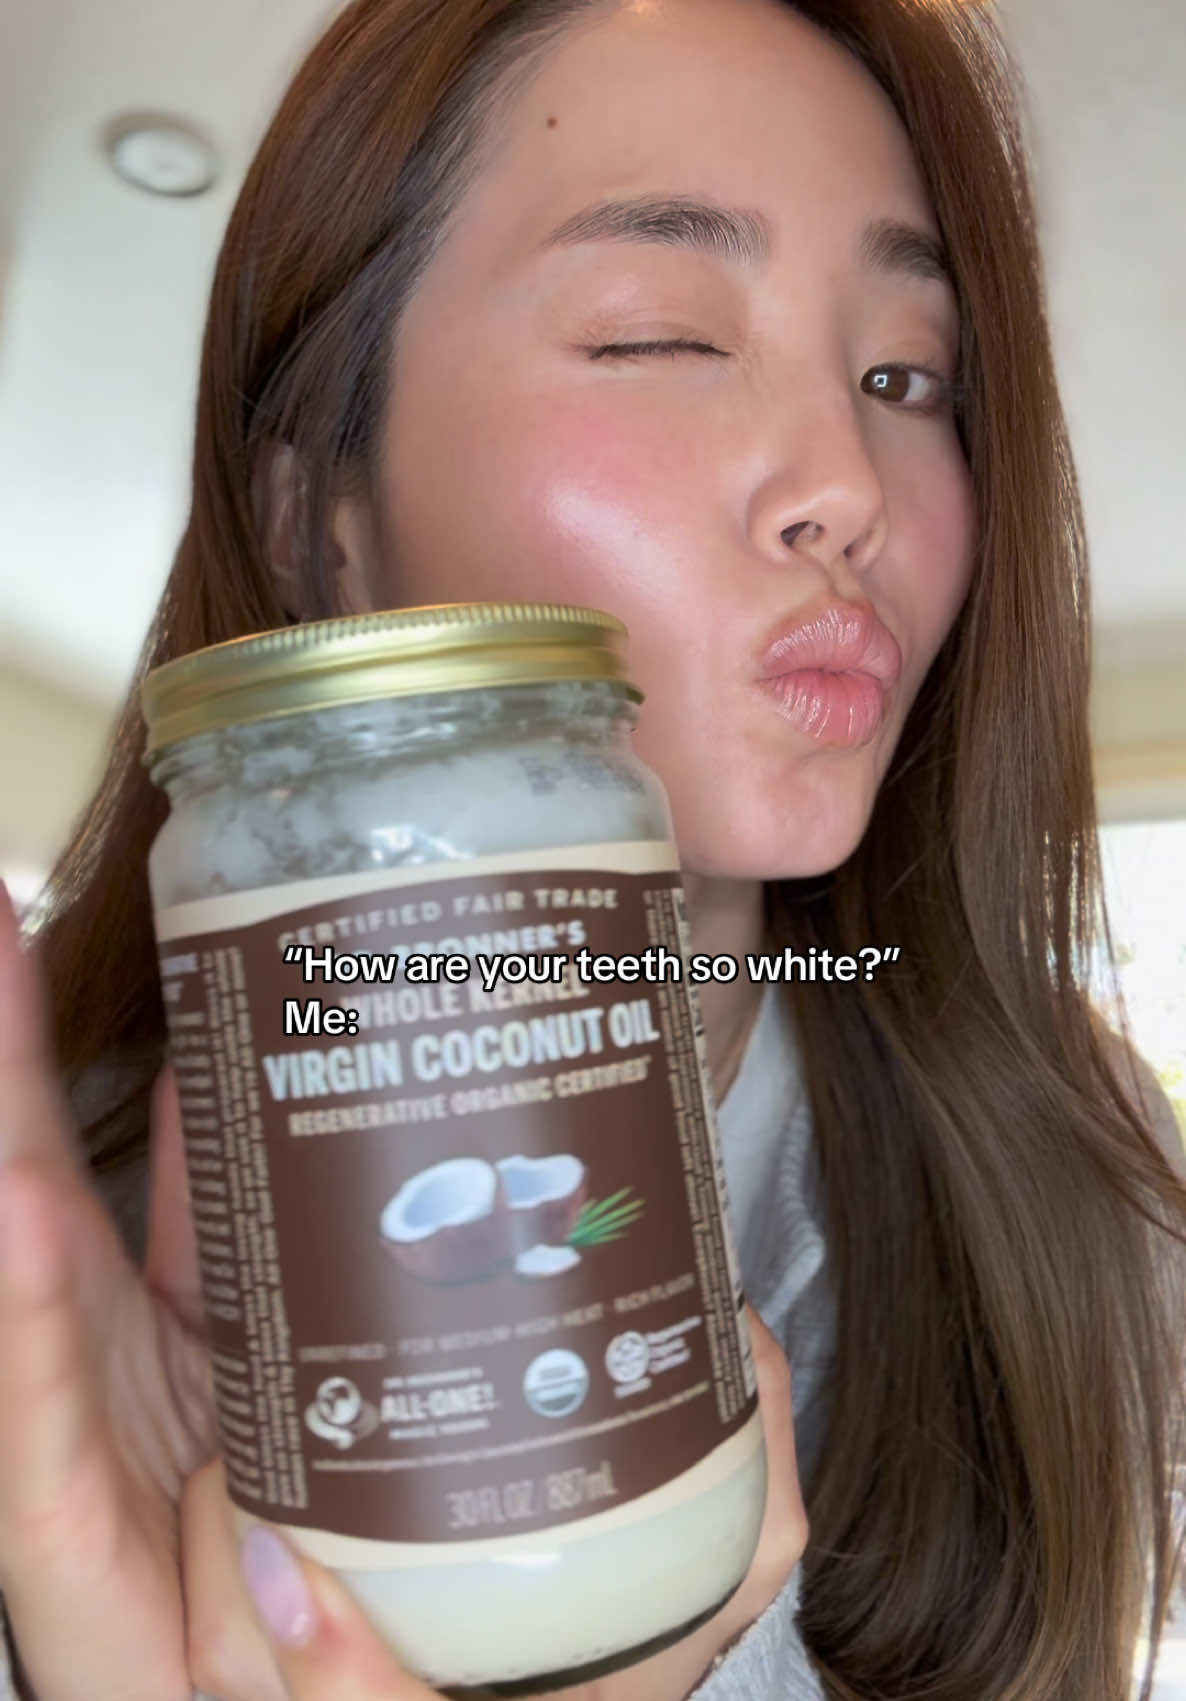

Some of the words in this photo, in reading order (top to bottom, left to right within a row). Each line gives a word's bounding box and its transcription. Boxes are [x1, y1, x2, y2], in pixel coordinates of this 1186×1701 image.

[278, 901, 442, 951] CERTIFIED
[453, 890, 525, 917] FAIR
[533, 888, 618, 909] TRADE
[341, 982, 464, 1030] WHOLE
[262, 1040, 403, 1101] VIRGIN
[411, 1008, 604, 1081] COCONUT
[608, 999, 661, 1048] OIL
